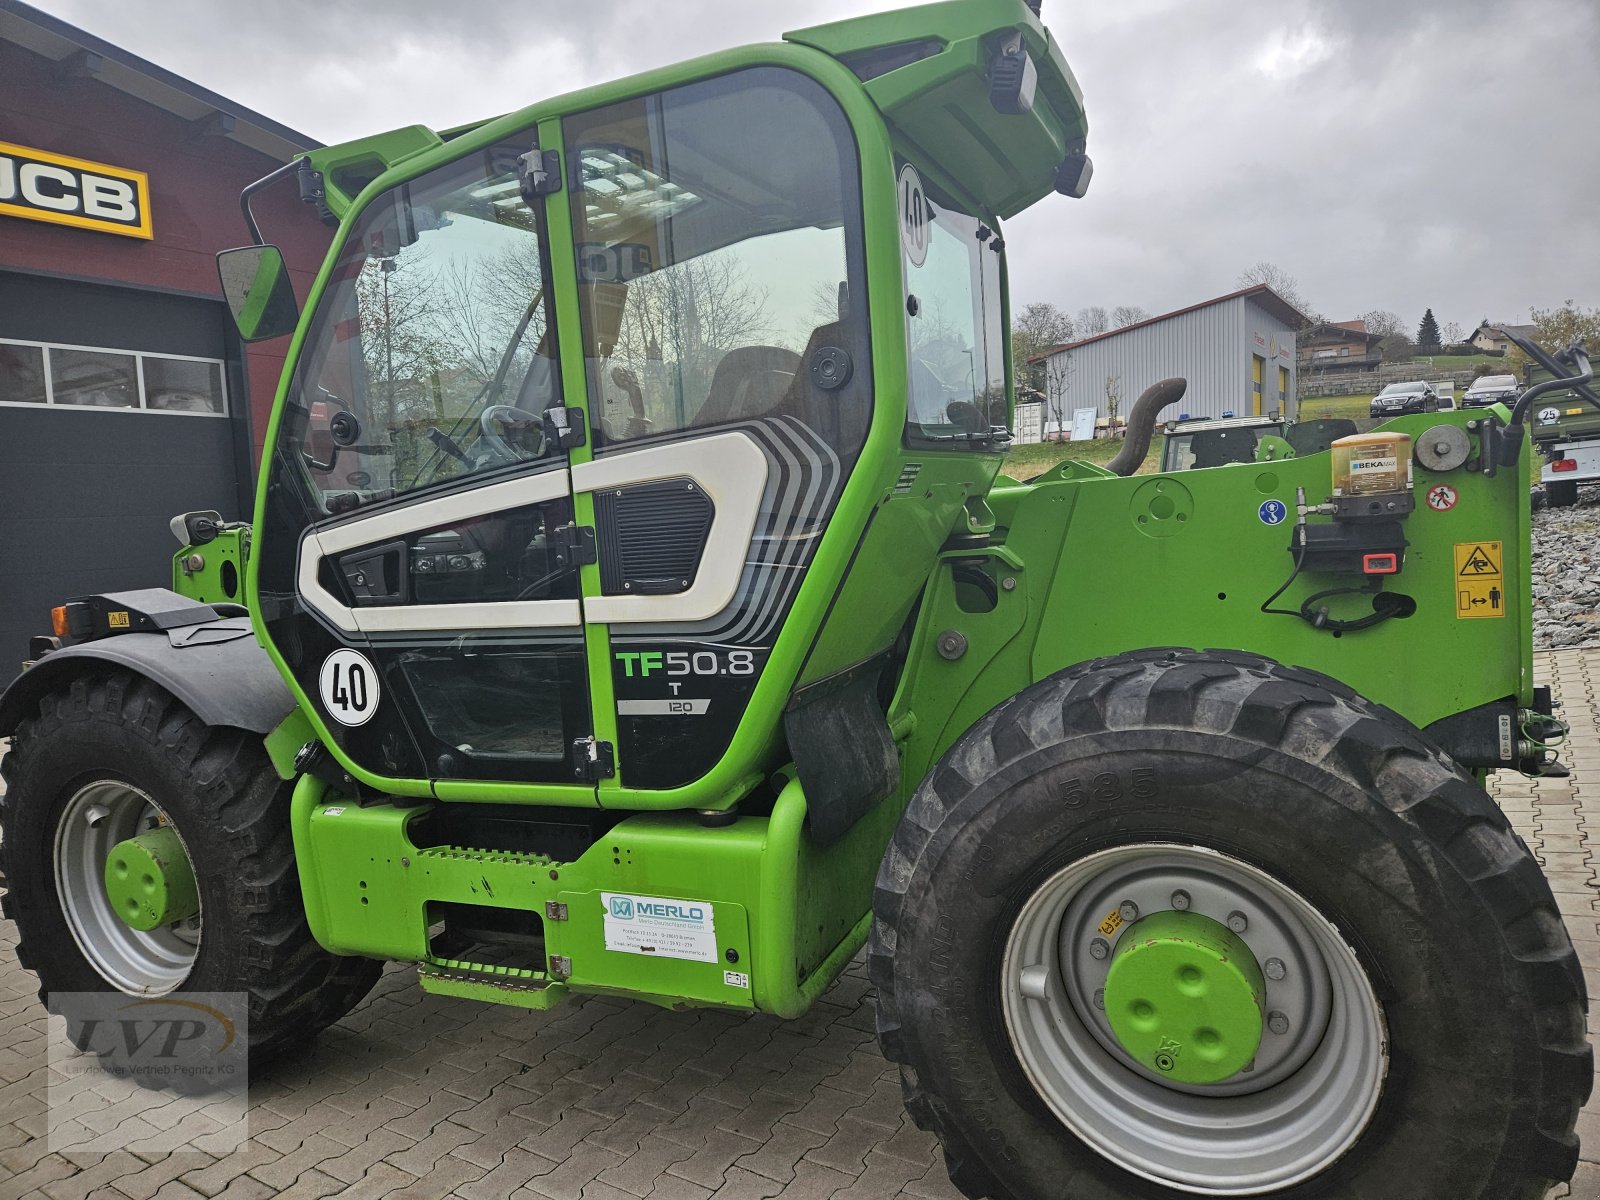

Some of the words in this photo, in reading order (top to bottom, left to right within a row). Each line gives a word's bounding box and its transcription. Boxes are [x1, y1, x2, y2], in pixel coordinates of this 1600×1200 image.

[0, 156, 137, 221] JCB
[905, 179, 924, 250] 40
[1358, 461, 1396, 469] BEKAMAX
[615, 651, 754, 677] TF50.8
[332, 663, 368, 712] 40
[668, 682, 682, 696] T
[668, 702, 693, 712] 120
[1059, 765, 1160, 810] 585
[636, 902, 704, 920] MERLO
